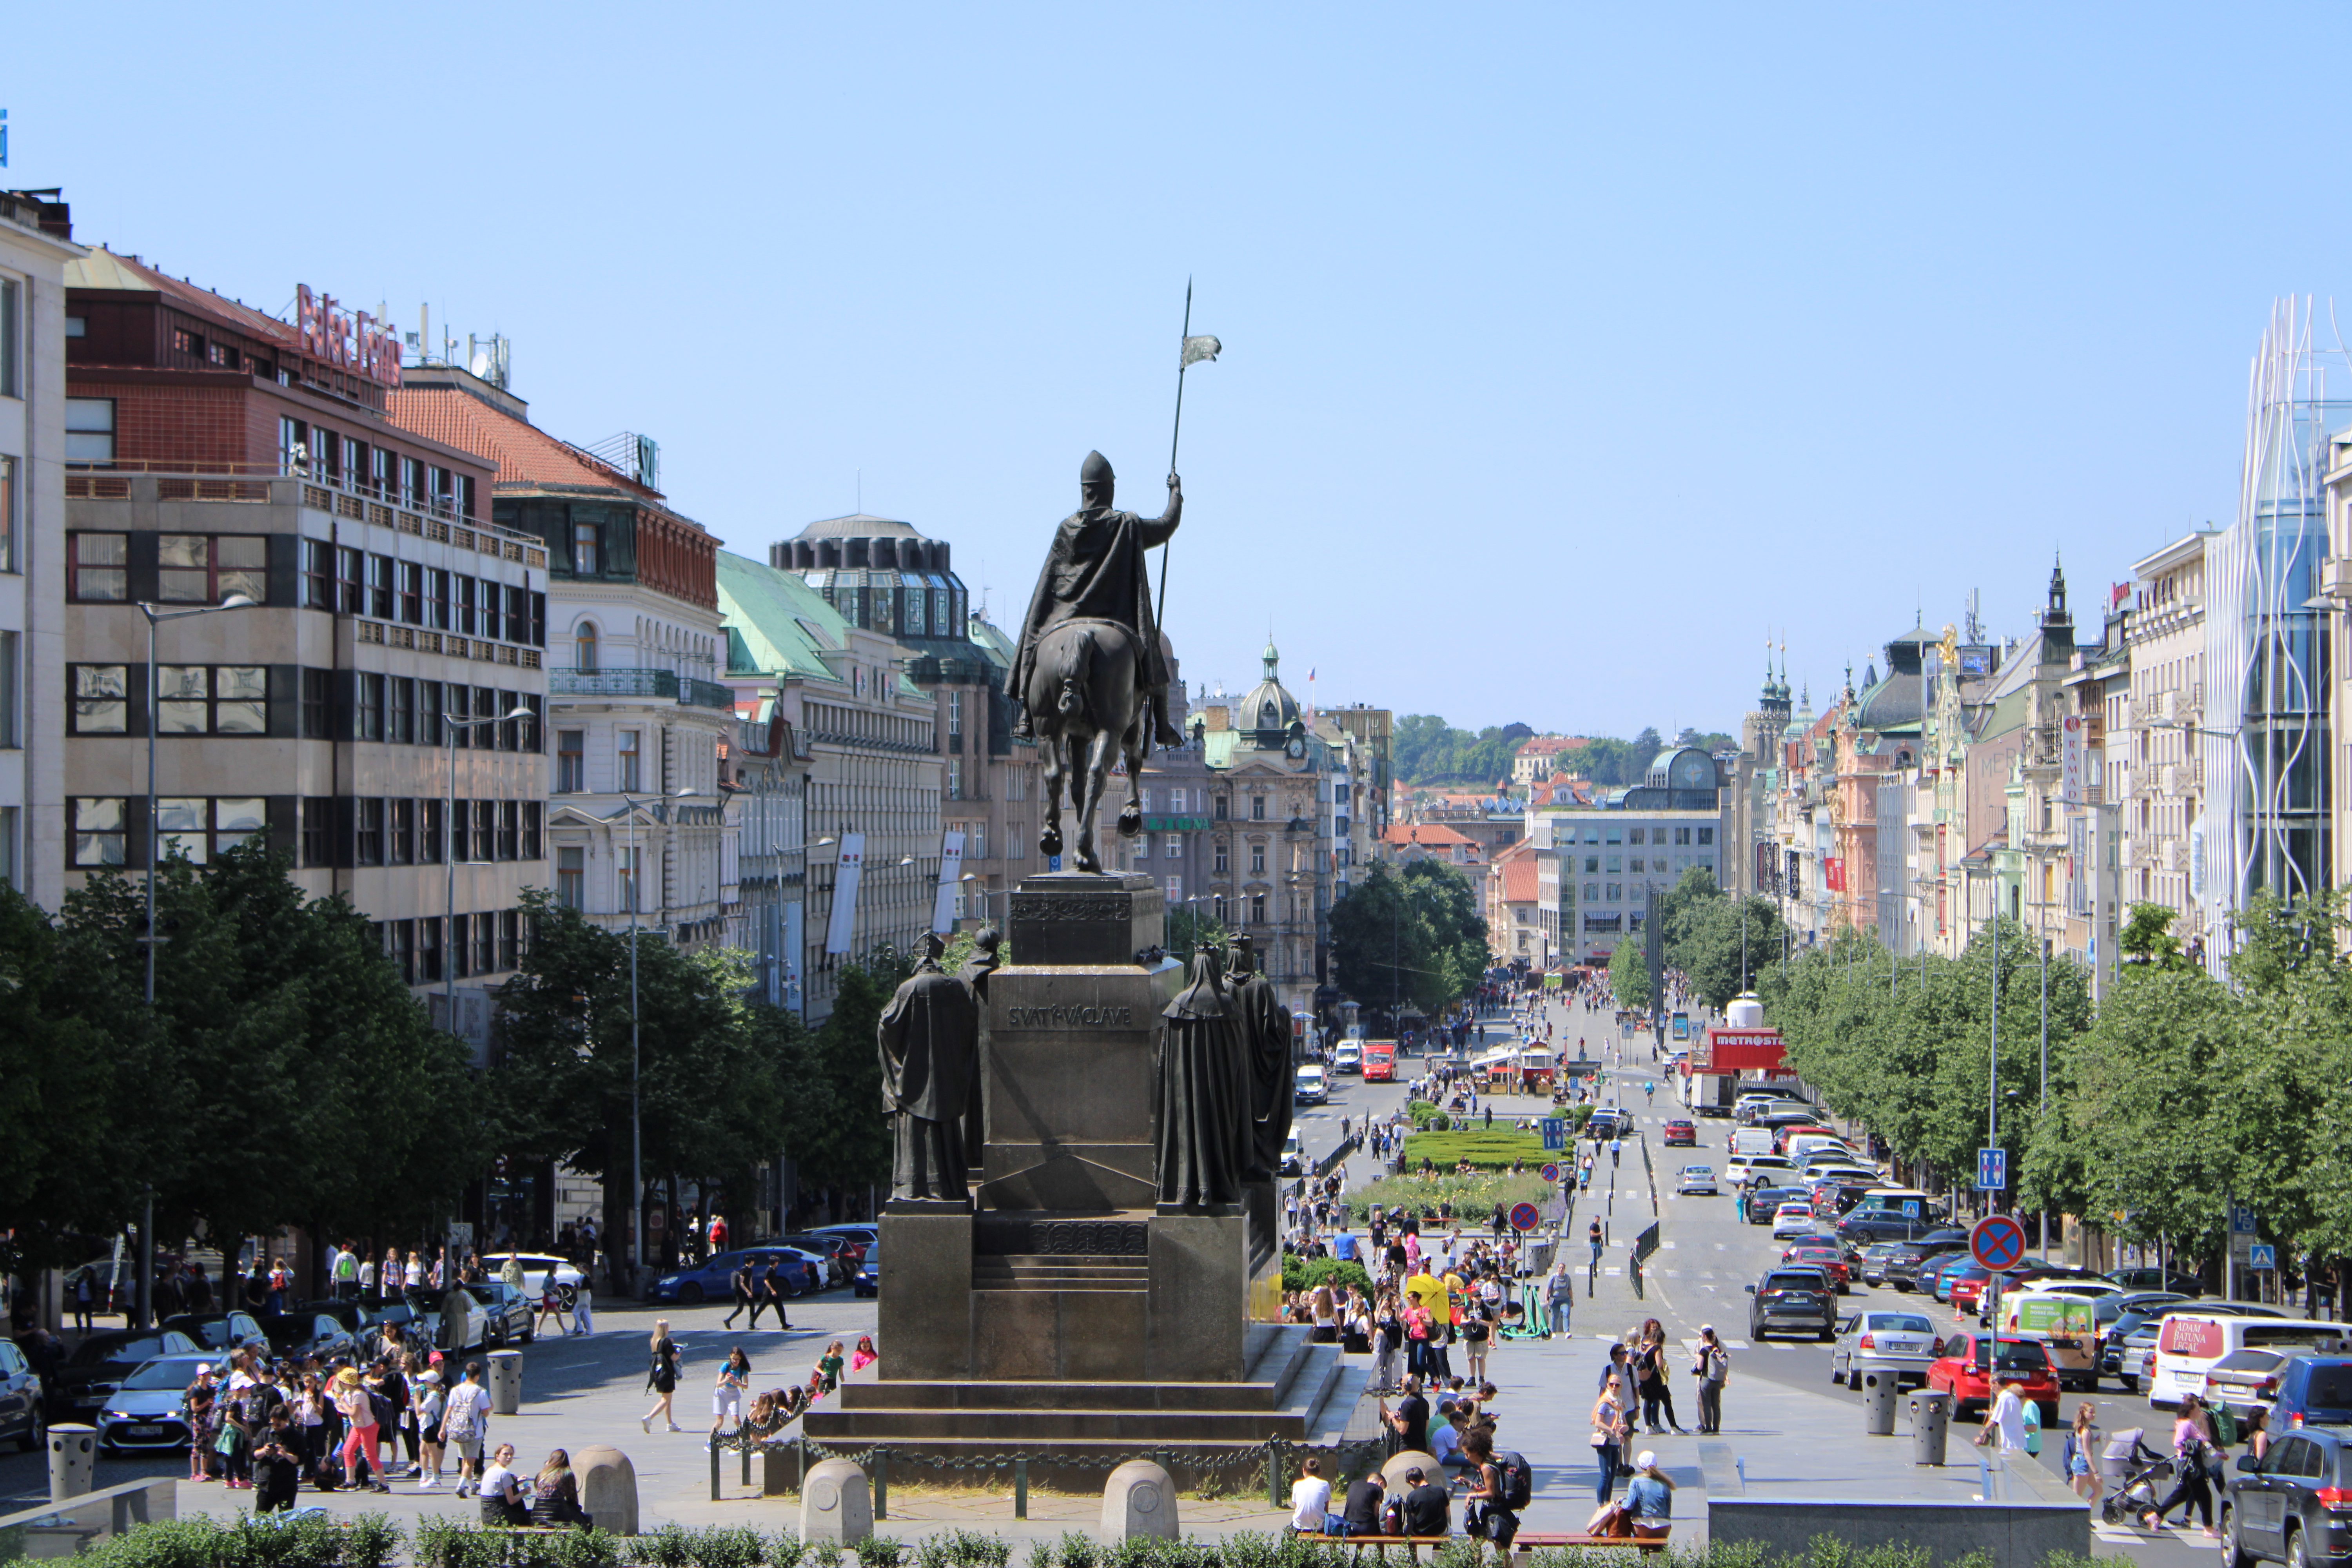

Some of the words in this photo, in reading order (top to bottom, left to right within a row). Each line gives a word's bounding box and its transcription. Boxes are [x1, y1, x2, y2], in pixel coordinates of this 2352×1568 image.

[2068, 740, 2077, 812] RAMADA
[1147, 818, 1209, 830] LIGNA
[2176, 1321, 2201, 1333] ADAM
[2174, 1330, 2206, 1343] BATUNA
[2173, 1341, 2199, 1352] LEGAL
